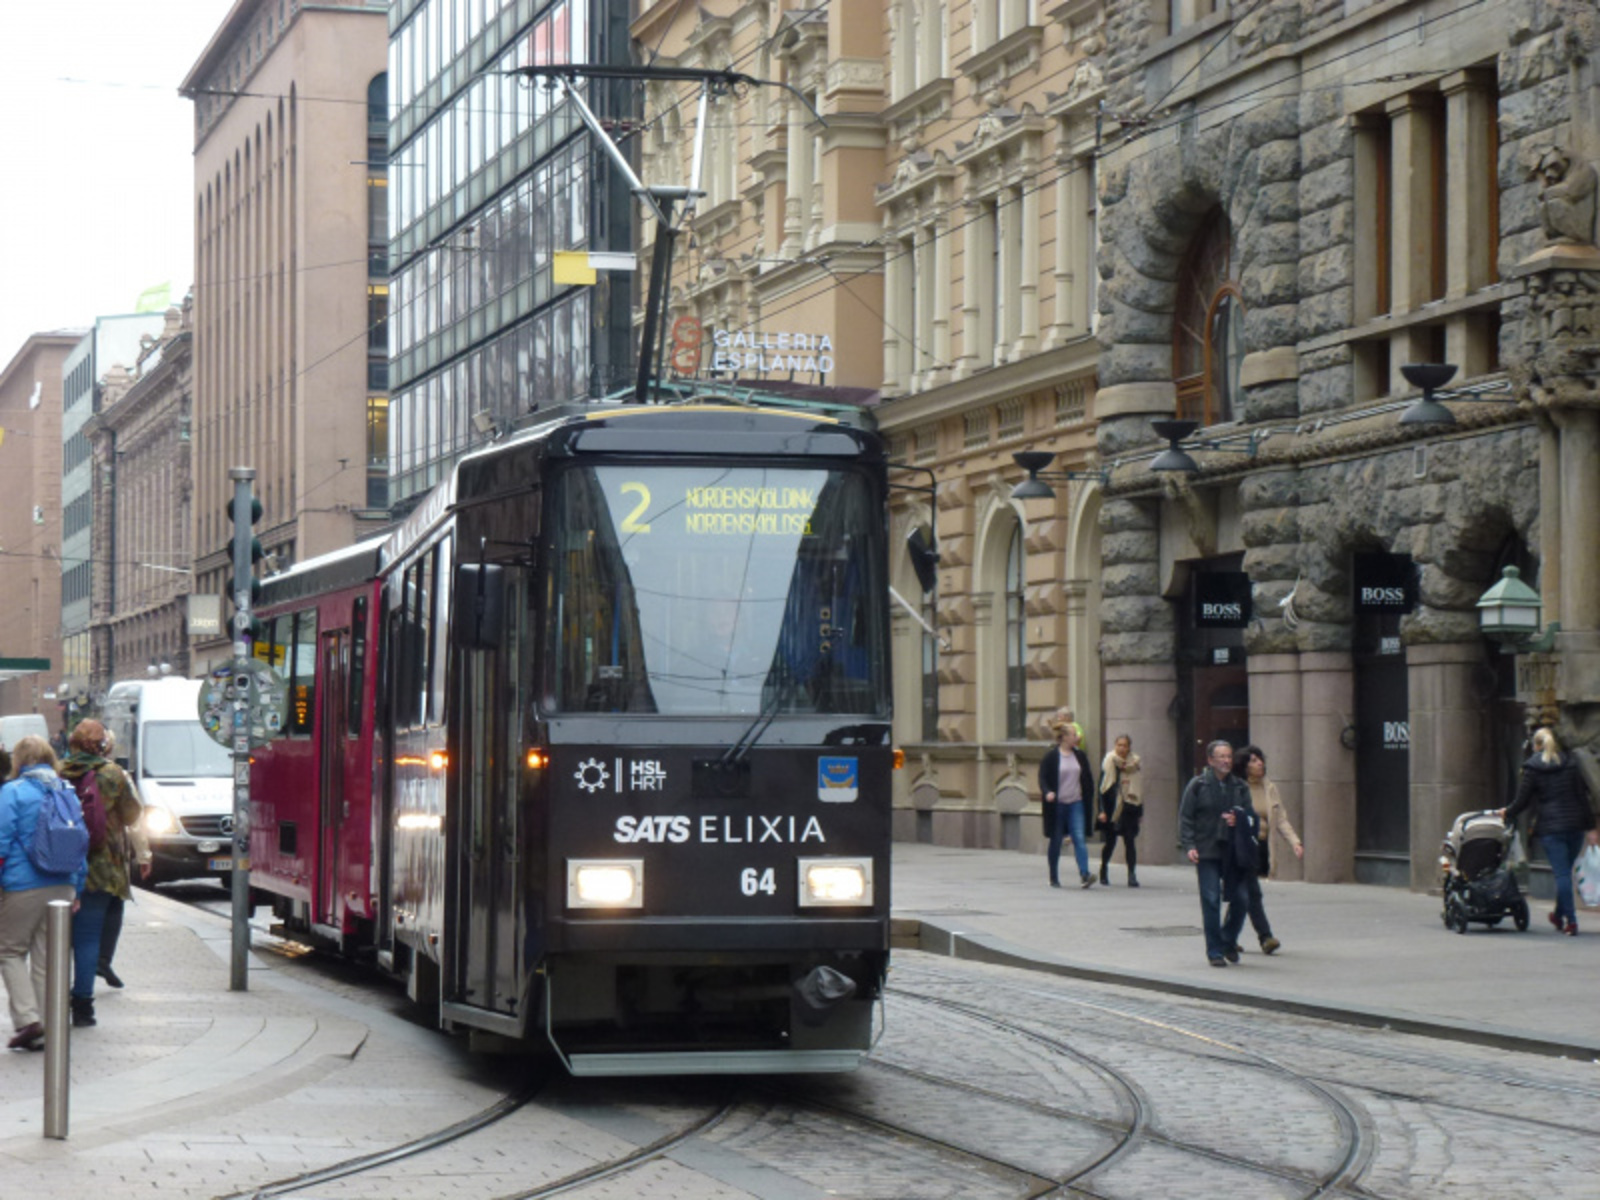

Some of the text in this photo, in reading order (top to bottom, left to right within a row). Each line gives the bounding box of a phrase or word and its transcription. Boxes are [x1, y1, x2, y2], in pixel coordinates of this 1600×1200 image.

[714, 329, 833, 351] GALLERIA
[714, 352, 834, 374] ESPLANAD
[619, 481, 651, 534] 2
[1361, 588, 1404, 601] BOSS
[1203, 603, 1241, 615] BOSS
[631, 760, 666, 775] HSL
[631, 776, 665, 791] HRT
[613, 815, 825, 843] SATS ELIXIA
[741, 867, 776, 896] 64
